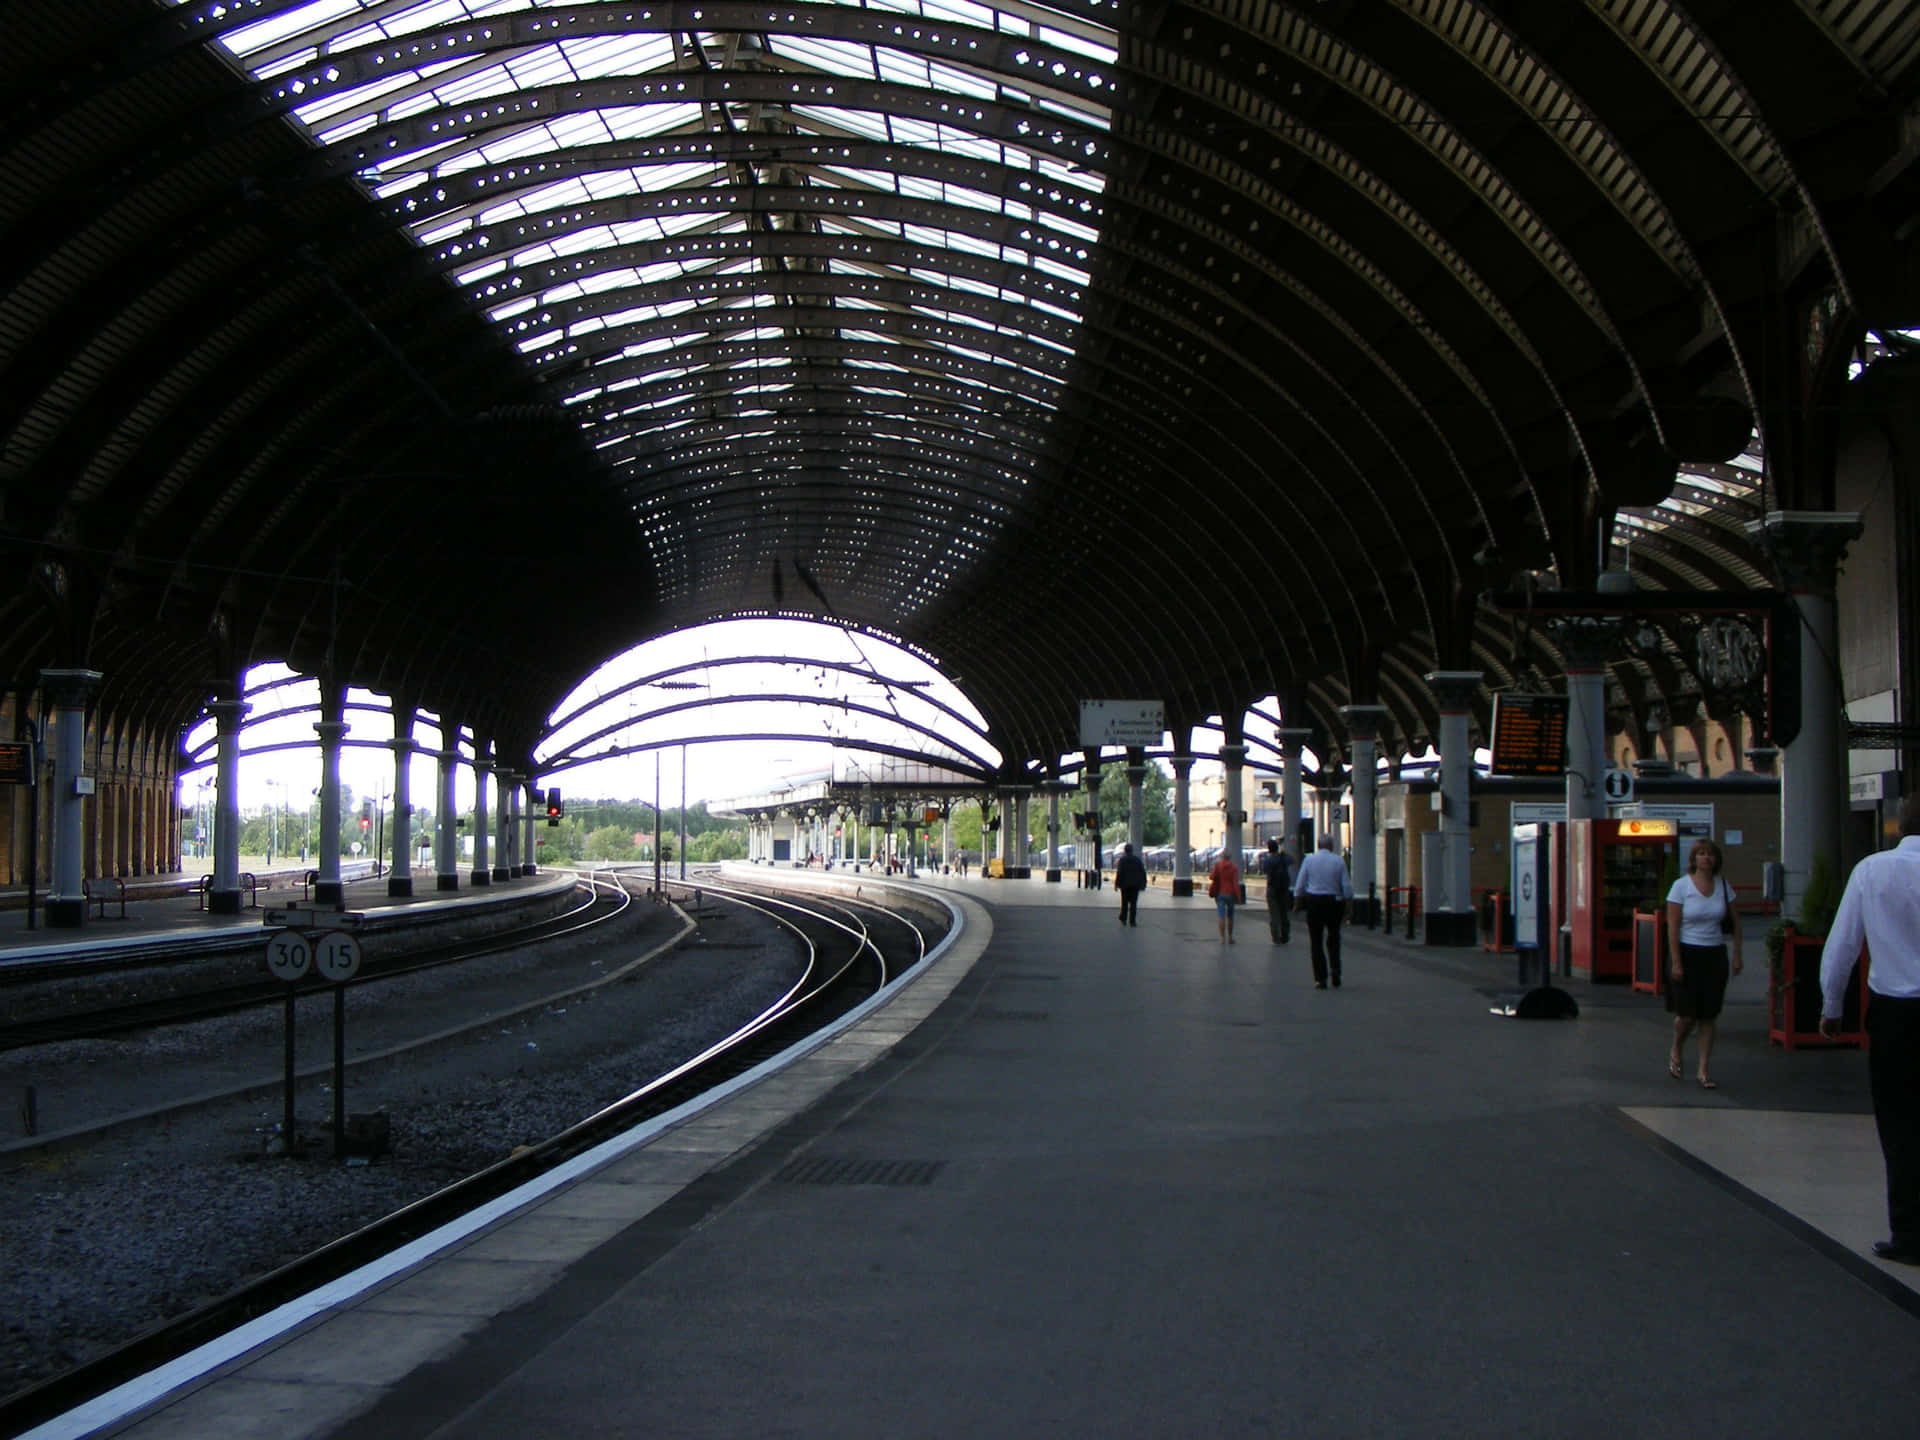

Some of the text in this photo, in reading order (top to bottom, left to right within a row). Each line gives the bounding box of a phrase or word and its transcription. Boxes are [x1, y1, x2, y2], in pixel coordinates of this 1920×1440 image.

[1333, 807, 1342, 820] 2
[274, 944, 307, 969] 30
[328, 944, 352, 969] 15
